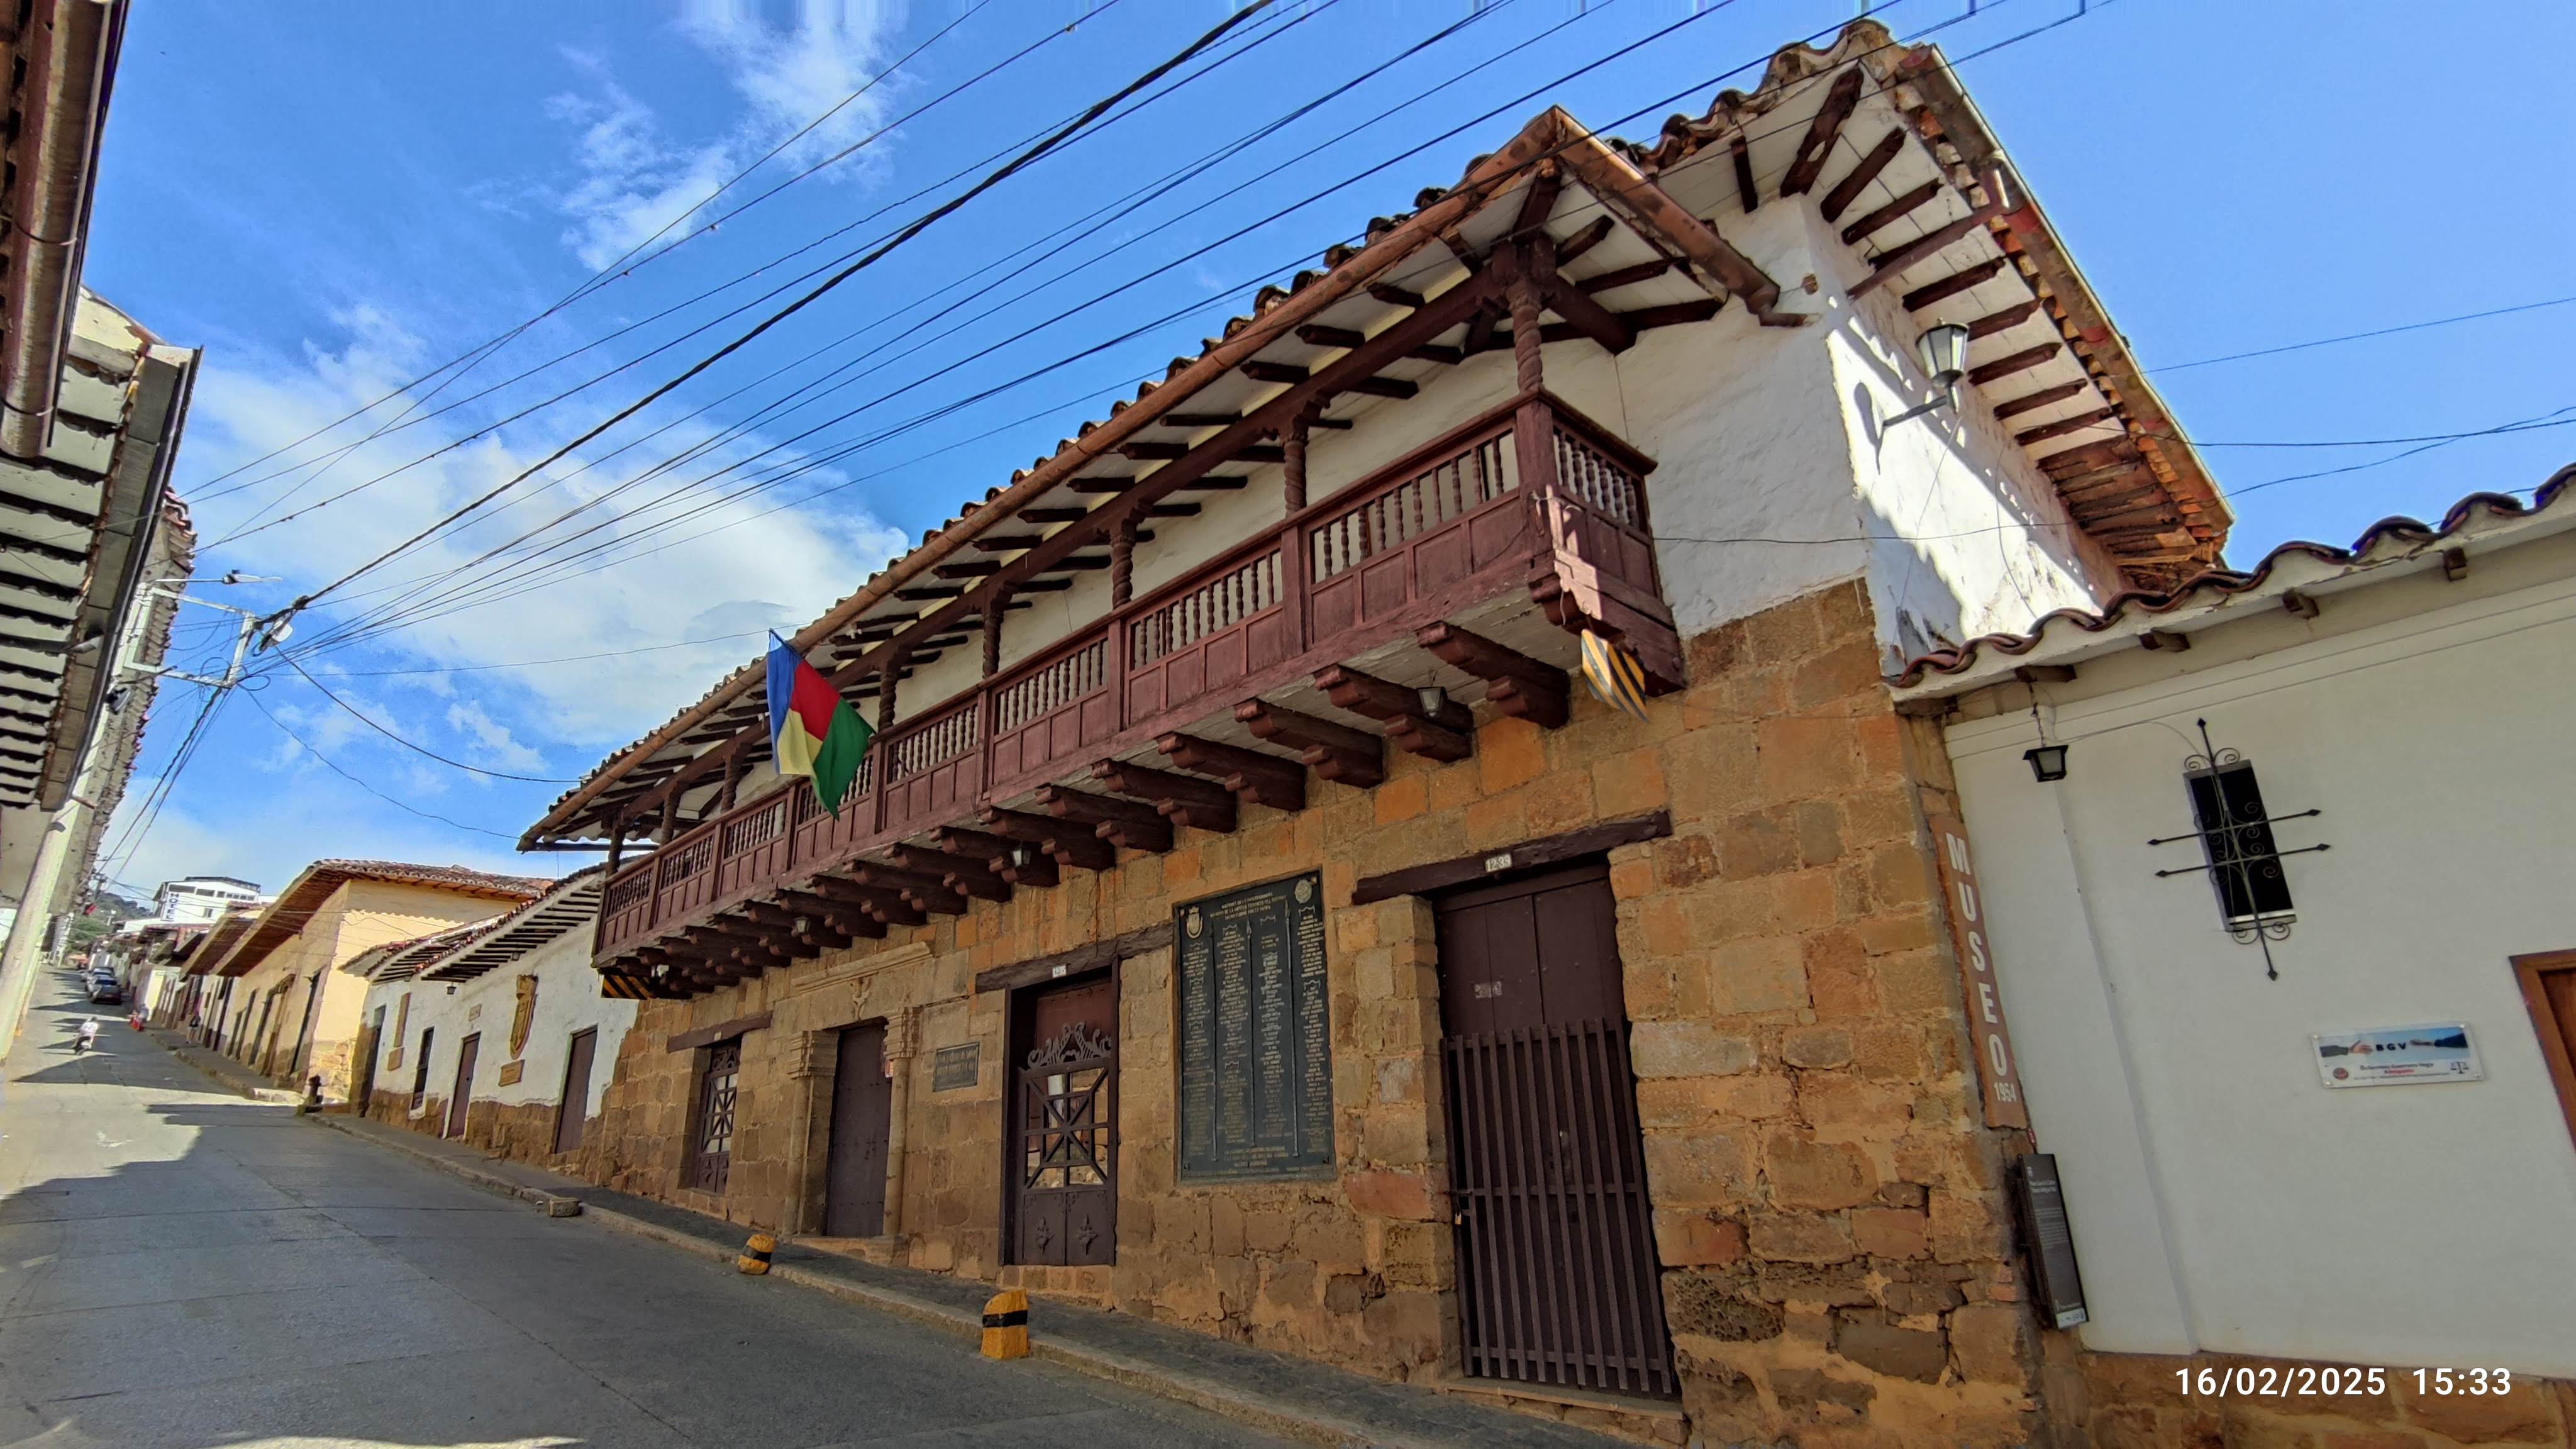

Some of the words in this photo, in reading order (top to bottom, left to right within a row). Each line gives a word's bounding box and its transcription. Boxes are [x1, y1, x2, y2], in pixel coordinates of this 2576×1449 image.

[1485, 854, 1511, 872] 12-39
[1946, 833, 2007, 1076] MUSEO
[1994, 1082, 2017, 1102] 1954
